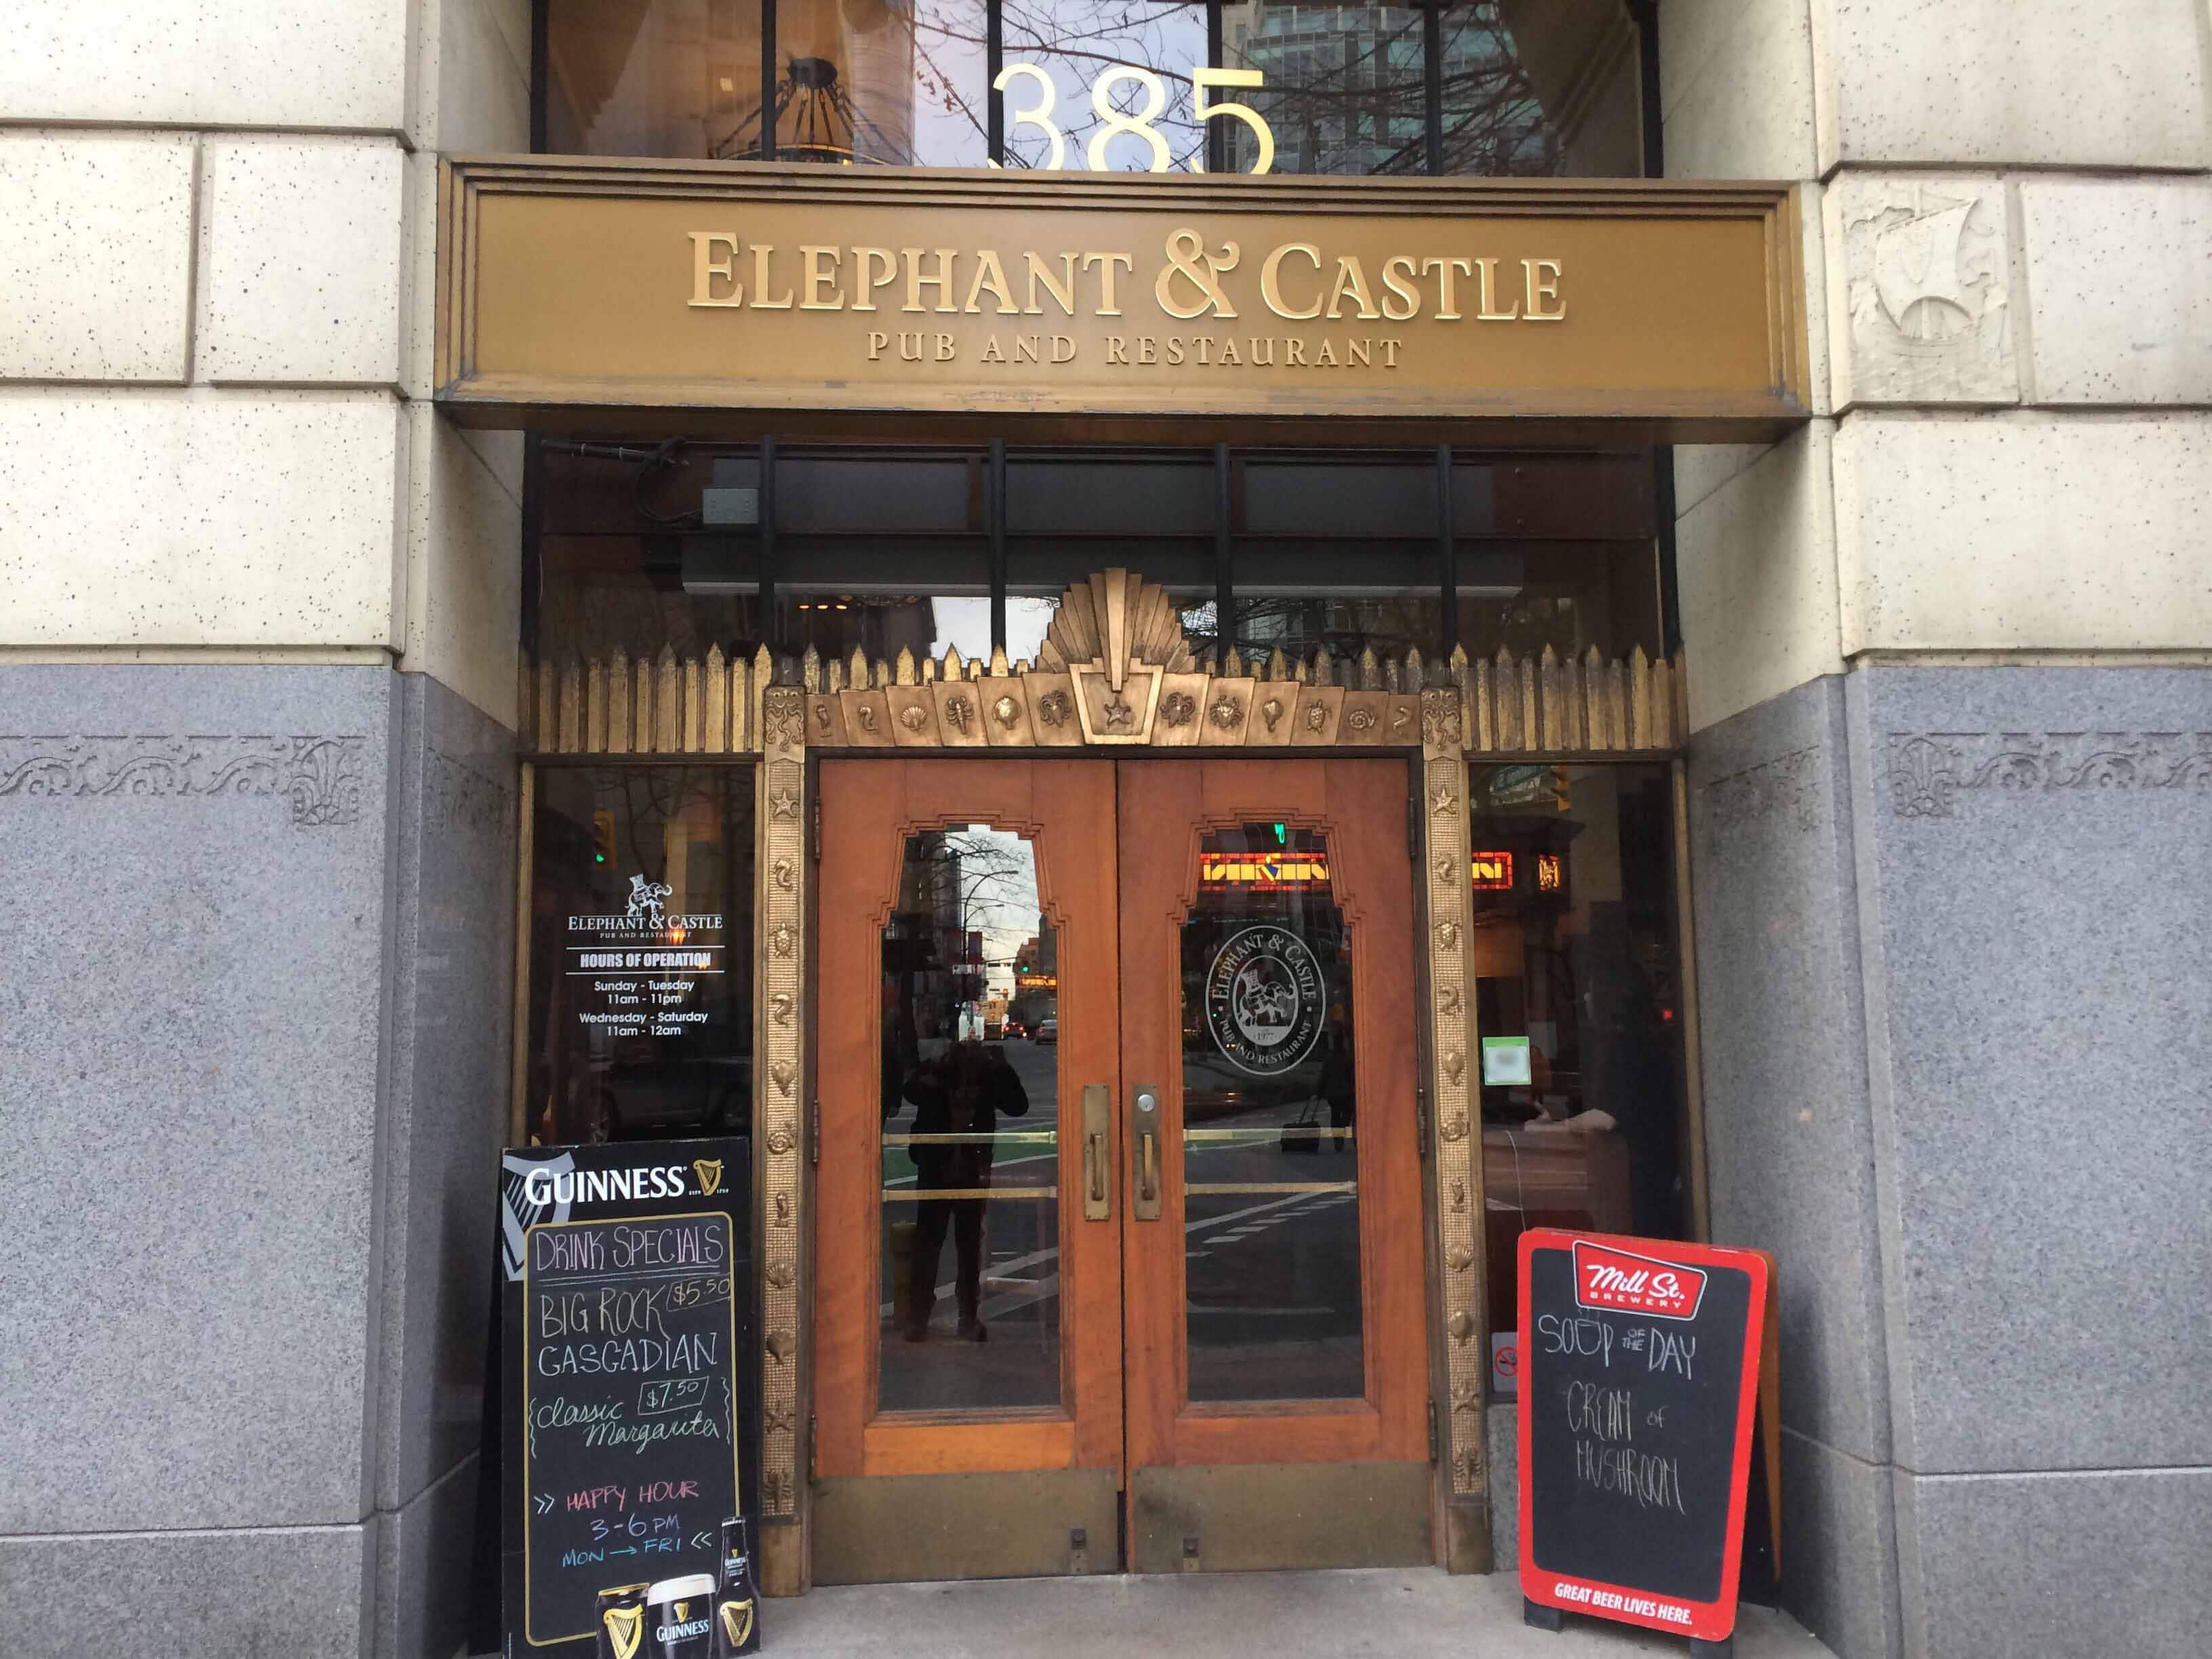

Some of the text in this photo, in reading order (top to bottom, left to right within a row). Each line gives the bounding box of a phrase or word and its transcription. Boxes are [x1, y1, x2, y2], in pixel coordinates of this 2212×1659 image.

[987, 62, 1275, 173] 385
[687, 228, 1567, 321] ELEPHANT & CASTLE
[868, 331, 1401, 367] PUB AND RESTAURANT
[568, 913, 722, 930] ELEPHANT & CASTLE
[580, 953, 711, 968] HOURS OF OPERATION
[1212, 933, 1316, 1000] ELEPHANT & CASTLE
[594, 981, 637, 992] Sunday
[648, 980, 695, 992] Tuesday
[608, 994, 638, 1004] 11am
[651, 994, 682, 1006] 11pm
[579, 1012, 647, 1024] Wednesday
[657, 1012, 708, 1023] Saturday
[607, 1026, 638, 1036] 11am
[650, 1025, 681, 1036] 12am
[1258, 1020, 1312, 1063] RESTAURANT
[525, 1166, 685, 1206] GUINNESS
[536, 1225, 723, 1271] DRINK SPECIALS
[1586, 1265, 1685, 1299] Mill St.
[541, 1277, 731, 1341] BIG ROCK $5.50
[1590, 1292, 1681, 1309] BREWERY
[1538, 1313, 1614, 1367] SOUP
[1648, 1327, 1696, 1380] DAY
[646, 1381, 699, 1408] $7.50
[1568, 1380, 1631, 1441] CREAM
[1577, 1440, 1686, 1516] MUSHROOM
[567, 1480, 699, 1512] HAPPY HOUR
[653, 1514, 680, 1534] PM
[562, 1538, 681, 1567] MON FRI
[1555, 1583, 1692, 1625] GREAT BEER LIVES HERE.
[656, 1619, 709, 1642] GUINNESS
